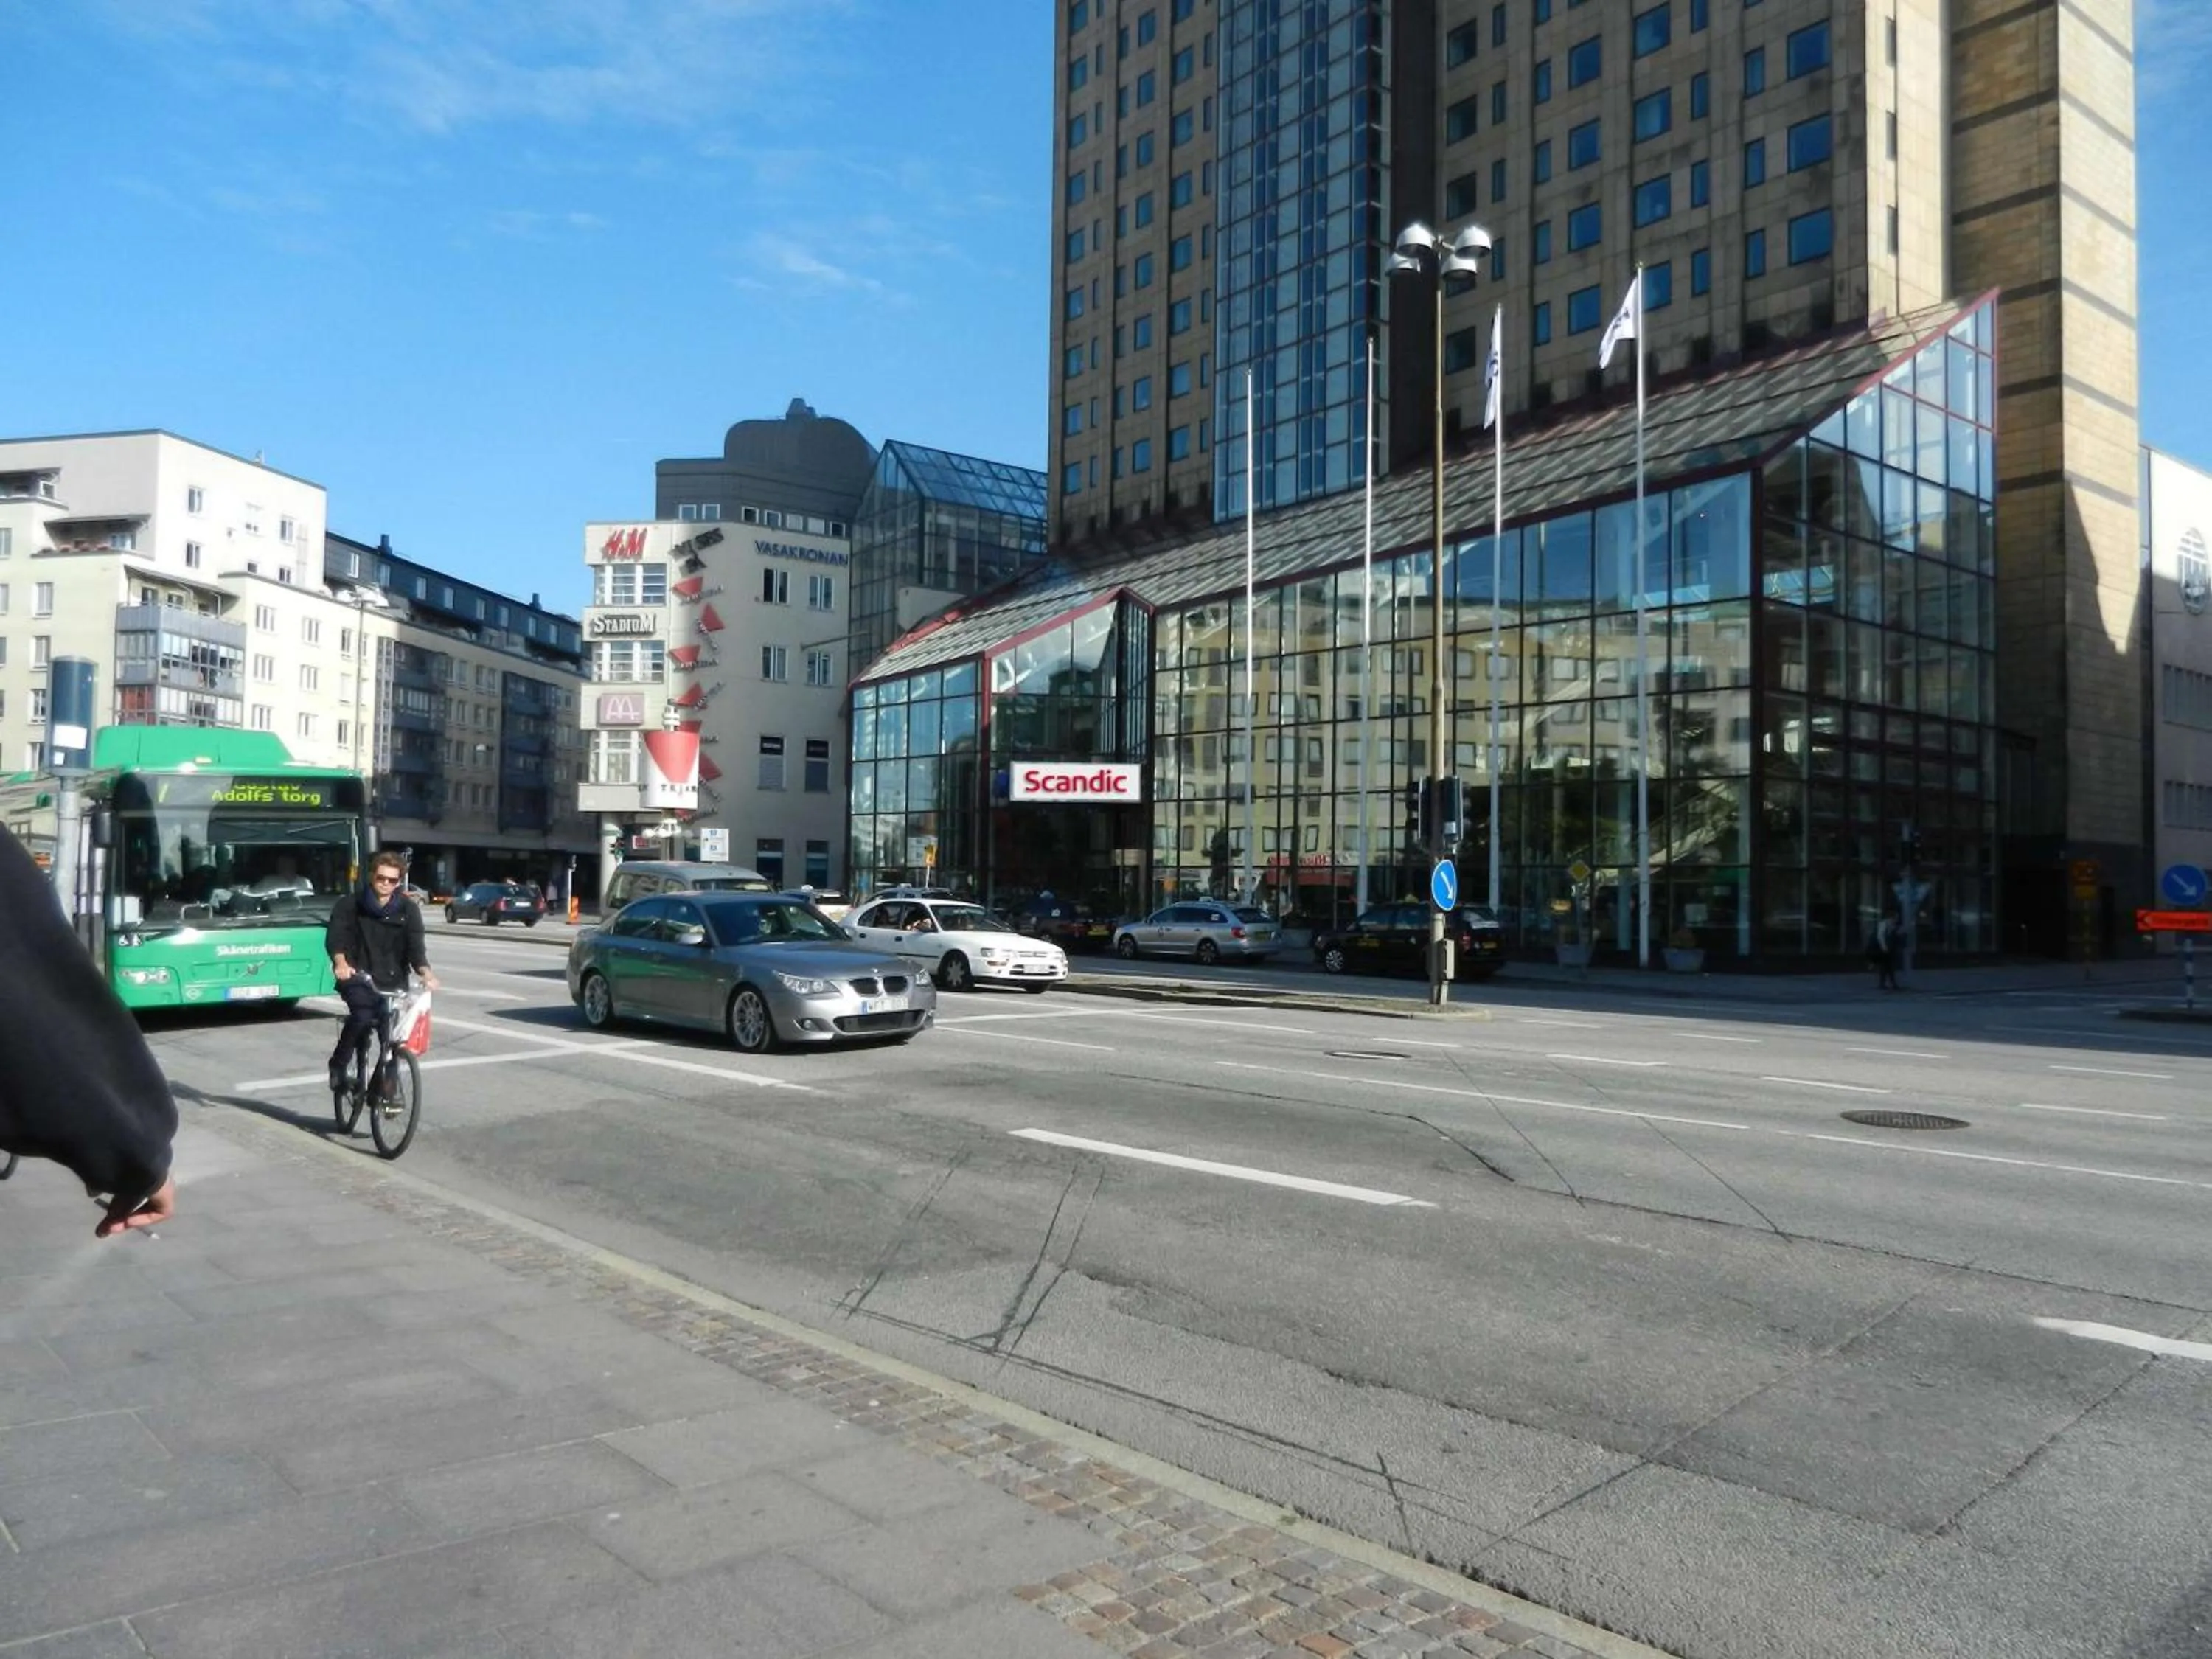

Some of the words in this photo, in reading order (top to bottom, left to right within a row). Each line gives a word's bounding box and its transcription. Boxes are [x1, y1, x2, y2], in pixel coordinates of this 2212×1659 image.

[603, 527, 647, 557] H&M
[754, 539, 849, 566] VASAKRONAN
[593, 613, 655, 633] STADIUM
[1025, 769, 1127, 793] Scandic
[211, 790, 274, 801] Adolfs
[281, 789, 321, 805] torg
